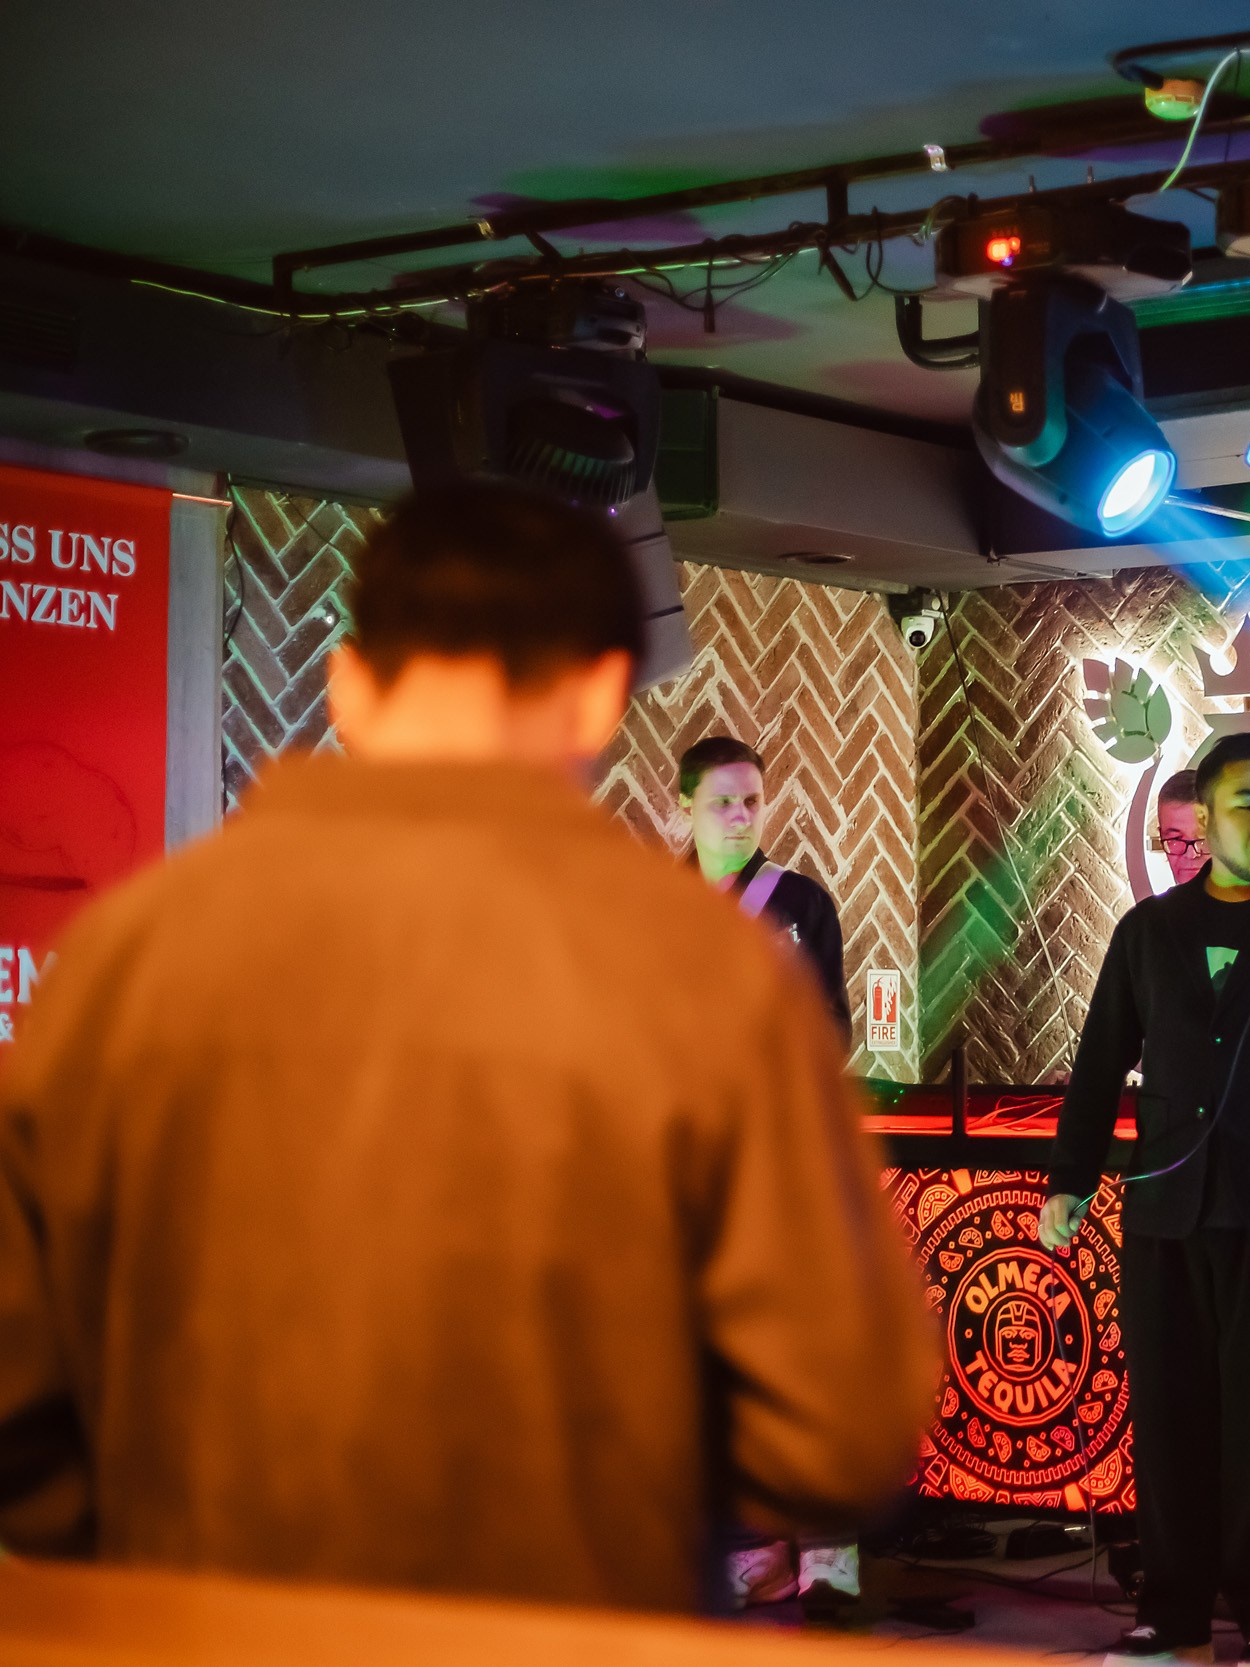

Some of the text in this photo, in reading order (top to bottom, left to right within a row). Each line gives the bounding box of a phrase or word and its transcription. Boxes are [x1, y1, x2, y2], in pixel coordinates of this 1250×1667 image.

[48, 529, 136, 577] UNS
[0, 581, 119, 631] NZEN
[871, 1026, 896, 1040] FIRE
[964, 1261, 1072, 1319] OLMECA
[965, 1350, 1077, 1414] TEQUILA
